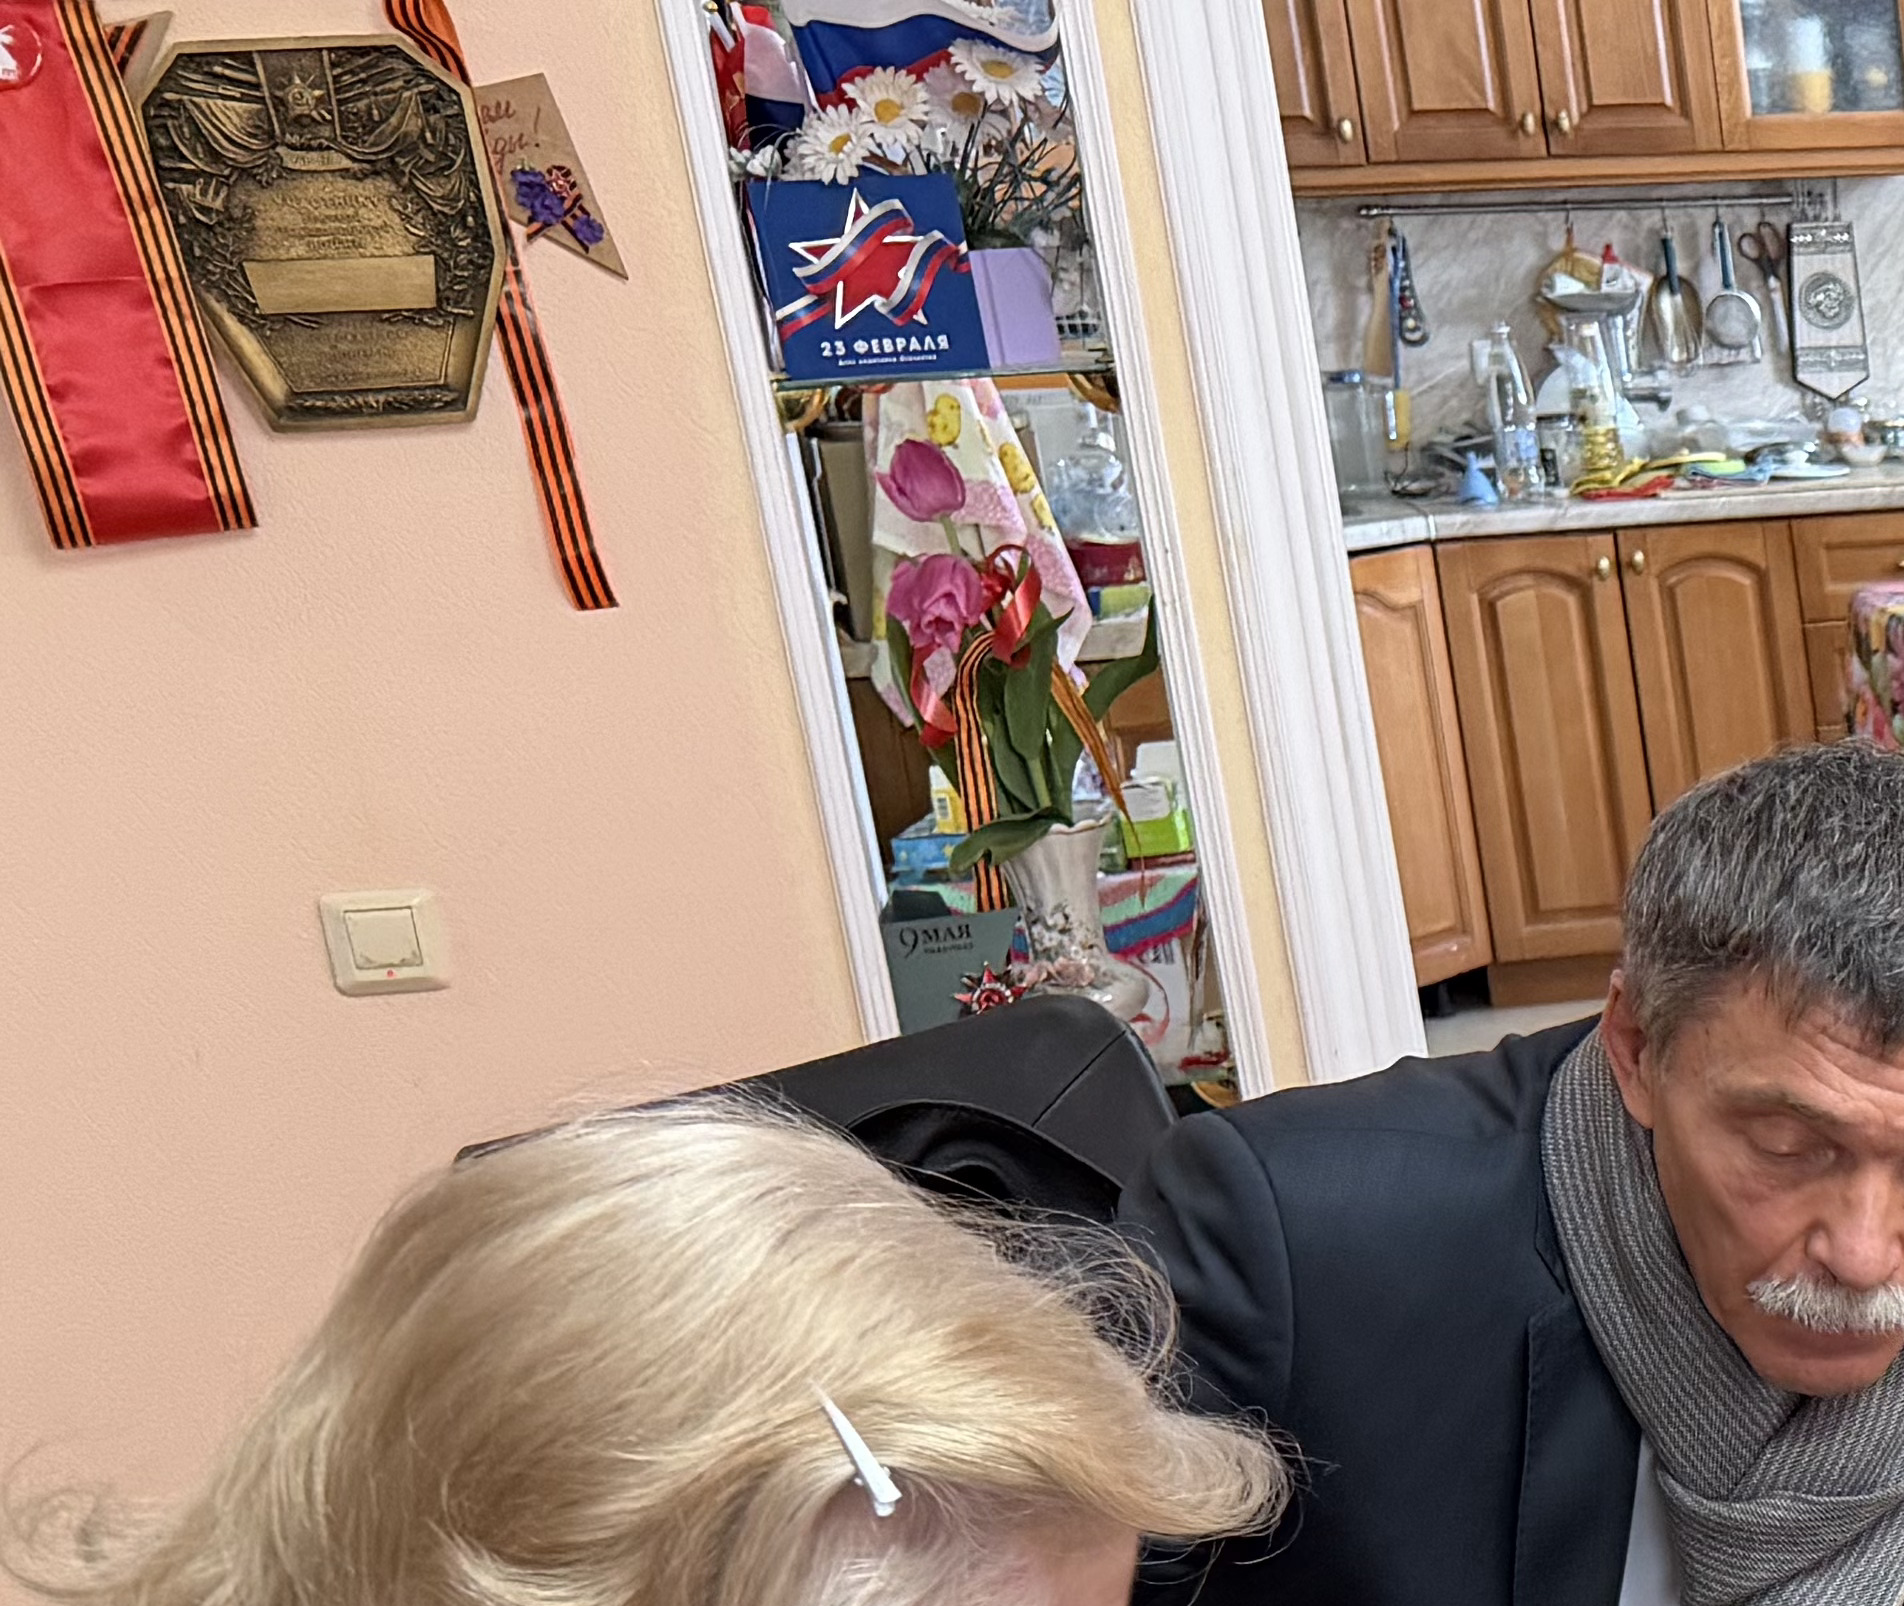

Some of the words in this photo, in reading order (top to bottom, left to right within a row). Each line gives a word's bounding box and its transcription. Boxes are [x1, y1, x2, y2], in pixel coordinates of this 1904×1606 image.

[821, 340, 846, 357] 23
[853, 334, 949, 354] ФЕВРАЛЯ
[900, 927, 918, 959] 9
[922, 923, 972, 944] МАЯ
